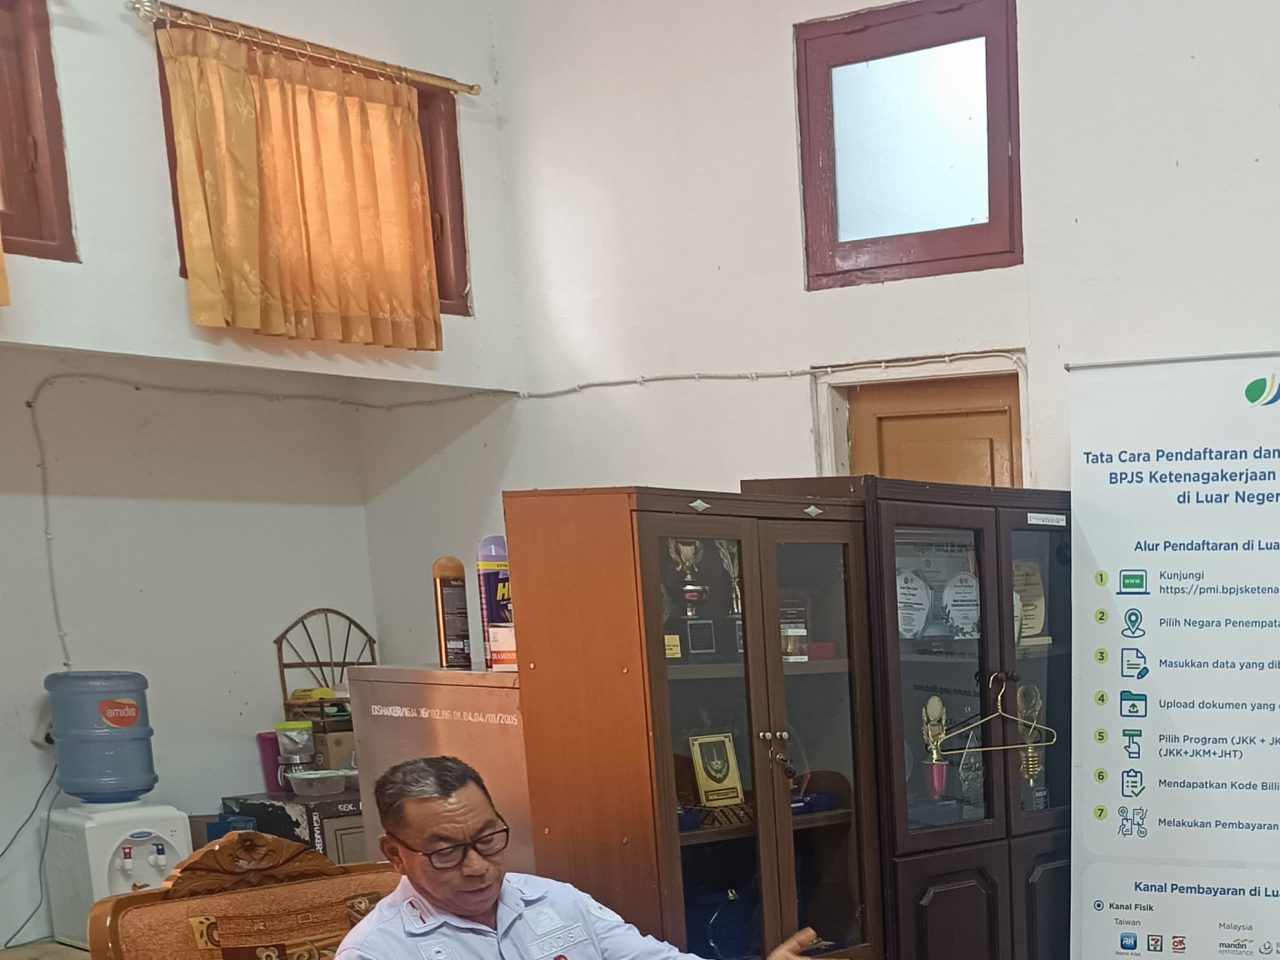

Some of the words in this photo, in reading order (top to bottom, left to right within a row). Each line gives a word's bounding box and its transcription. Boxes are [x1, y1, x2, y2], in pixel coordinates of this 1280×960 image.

[1084, 451, 1113, 464] Tata
[1118, 450, 1150, 463] Cara
[1156, 448, 1248, 462] Pendaftaran
[1253, 446, 1280, 460] dan
[1109, 471, 1144, 484] BPJS
[1150, 469, 1276, 484] Ketenagakerjaan
[1177, 491, 1190, 504] di
[1196, 492, 1230, 504] Luar
[1134, 540, 1160, 552] Alur
[1164, 540, 1238, 552] Pendaftaran
[1242, 540, 1254, 551] di
[1160, 570, 1204, 582] Kunjungi
[1098, 612, 1105, 621] 2
[1160, 618, 1180, 628] Pilih
[1184, 618, 1222, 630] Negara
[1098, 652, 1104, 662] 3
[1159, 659, 1209, 669] Masukkan
[1212, 660, 1236, 670] data
[1239, 662, 1264, 672] yang
[1098, 694, 1105, 702] 4
[106, 707, 136, 718] amidis
[1159, 700, 1195, 712] Upload
[1198, 700, 1247, 710] dokumen
[1250, 703, 1276, 713] yang
[1098, 732, 1104, 742] 5
[1159, 734, 1180, 744] Pilih
[1183, 736, 1228, 748] Program
[1231, 736, 1256, 747] (JKK
[1158, 748, 1243, 760] (JKK+JKM+JHT)
[1098, 772, 1104, 781] 6
[1158, 778, 1227, 791] Mendapatkan
[1230, 780, 1258, 791] Kode
[1098, 808, 1104, 818] 7
[1158, 818, 1212, 829] Melakukan
[1215, 820, 1279, 832] Pembayaran
[1134, 882, 1167, 892] Kanal
[1171, 884, 1246, 897] Pembayaran
[1250, 886, 1261, 897] di
[1109, 902, 1132, 911] Kanal
[1134, 904, 1154, 912] Fisik
[1114, 918, 1140, 926] Taiwan
[1218, 922, 1253, 931] Malaysia
